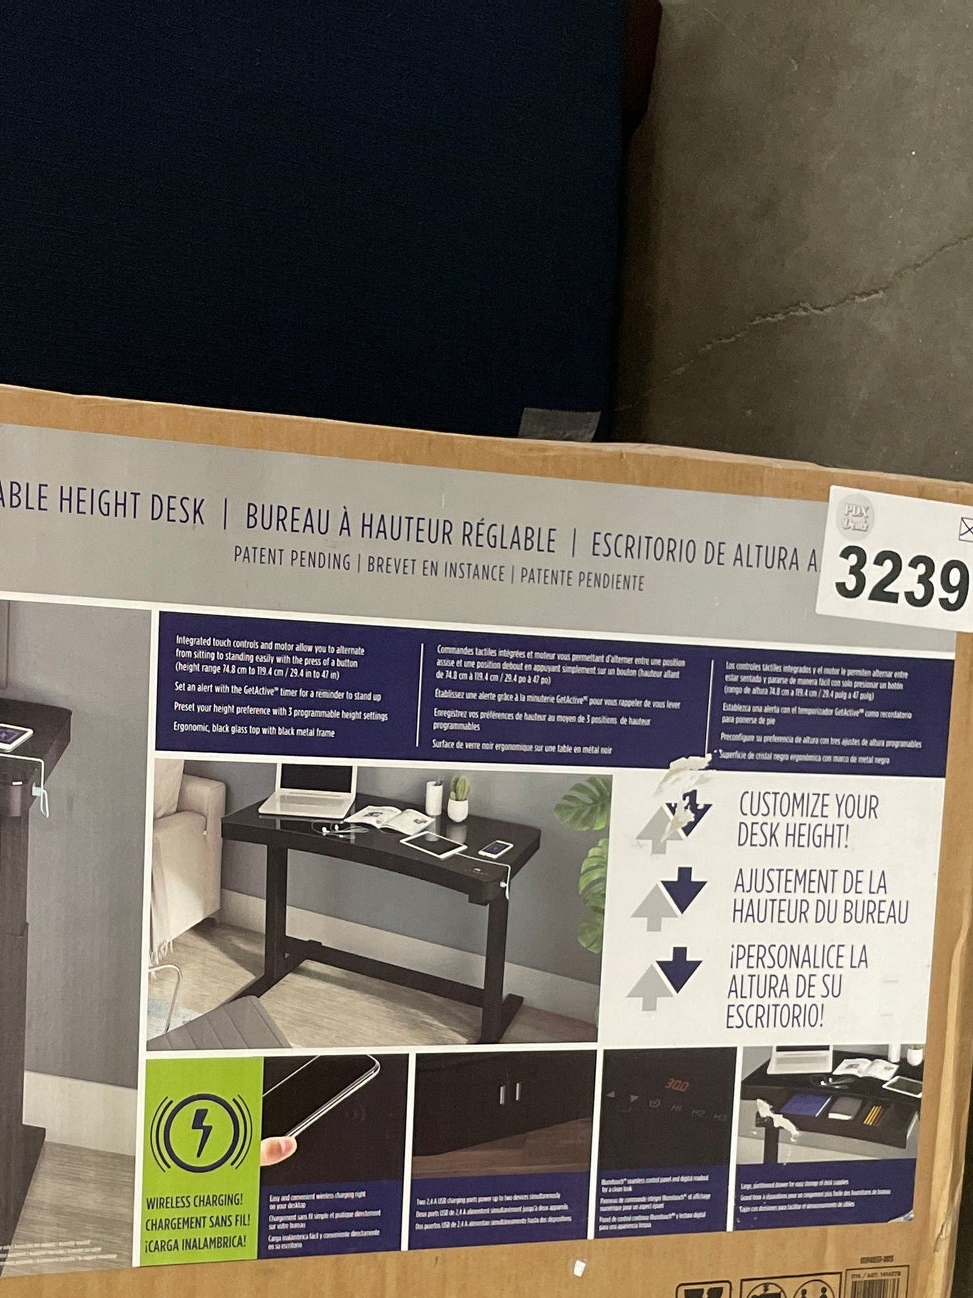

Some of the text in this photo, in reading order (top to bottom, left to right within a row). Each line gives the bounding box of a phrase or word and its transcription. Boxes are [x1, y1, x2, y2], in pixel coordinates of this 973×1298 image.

[844, 503, 870, 518] PDX
[60, 485, 139, 518] HEIGHT
[151, 493, 204, 524] DESK
[247, 502, 329, 535] BUREAU
[339, 507, 350, 536] À
[361, 512, 452, 545] HAUTEUR
[462, 518, 555, 552] RÉGLABLE
[592, 531, 695, 563] ESCRITORIO
[704, 540, 725, 565] DE
[733, 543, 798, 570] ALTURA
[234, 545, 643, 591] PATENT PENDING BREVET EN INSTANCE PATENTE PENDIENTE
[835, 545, 970, 612] 3239
[176, 634, 364, 655] Integrated touch controls and motor allow you to alternate
[176, 648, 192, 657] from
[193, 650, 215, 661] sitting
[217, 651, 223, 660] to
[225, 651, 253, 663] standing
[255, 653, 274, 663] easily
[276, 654, 290, 663] with
[292, 655, 303, 664] the
[304, 657, 321, 666] press
[323, 656, 329, 666] of
[336, 657, 357, 667] button
[175, 681, 185, 691] Set
[187, 683, 195, 691] an
[197, 682, 212, 692] alert
[215, 683, 229, 693] with
[231, 684, 242, 694] the
[280, 687, 297, 696] timer
[299, 687, 308, 697] for
[315, 690, 344, 699] reminder
[346, 690, 353, 699] to
[354, 691, 371, 700] stand
[373, 693, 381, 702] up
[174, 701, 194, 711] Preset
[197, 704, 211, 712] your
[213, 703, 234, 714] height
[236, 704, 270, 715] preference
[272, 706, 286, 715] with
[293, 709, 340, 718] programmable
[341, 709, 361, 720] height
[363, 711, 388, 721] settings
[212, 723, 229, 732] black
[231, 724, 247, 734] glass
[249, 725, 260, 735] top
[261, 726, 276, 734] with
[278, 726, 294, 735] black
[296, 727, 314, 736] metal
[316, 727, 335, 737] frame
[740, 790, 878, 819] CUSTOMIZE YOUR
[738, 821, 848, 848] DESK HEIGHT!
[734, 868, 886, 894] AJUSTEMENT DE LA
[733, 898, 908, 924] HAUTEUR DU BUREAU
[730, 943, 867, 968] ¡PERSONALICE LA
[727, 973, 841, 998] ALTURA DE SU
[726, 1003, 823, 1028] ESCRITORIO!
[146, 1193, 243, 1209] WIRELESS CHARGING!
[145, 1213, 250, 1231] CHARGEMENT SANS FIL!
[145, 1234, 246, 1253] ¡CARGA INALAMBRICA!
